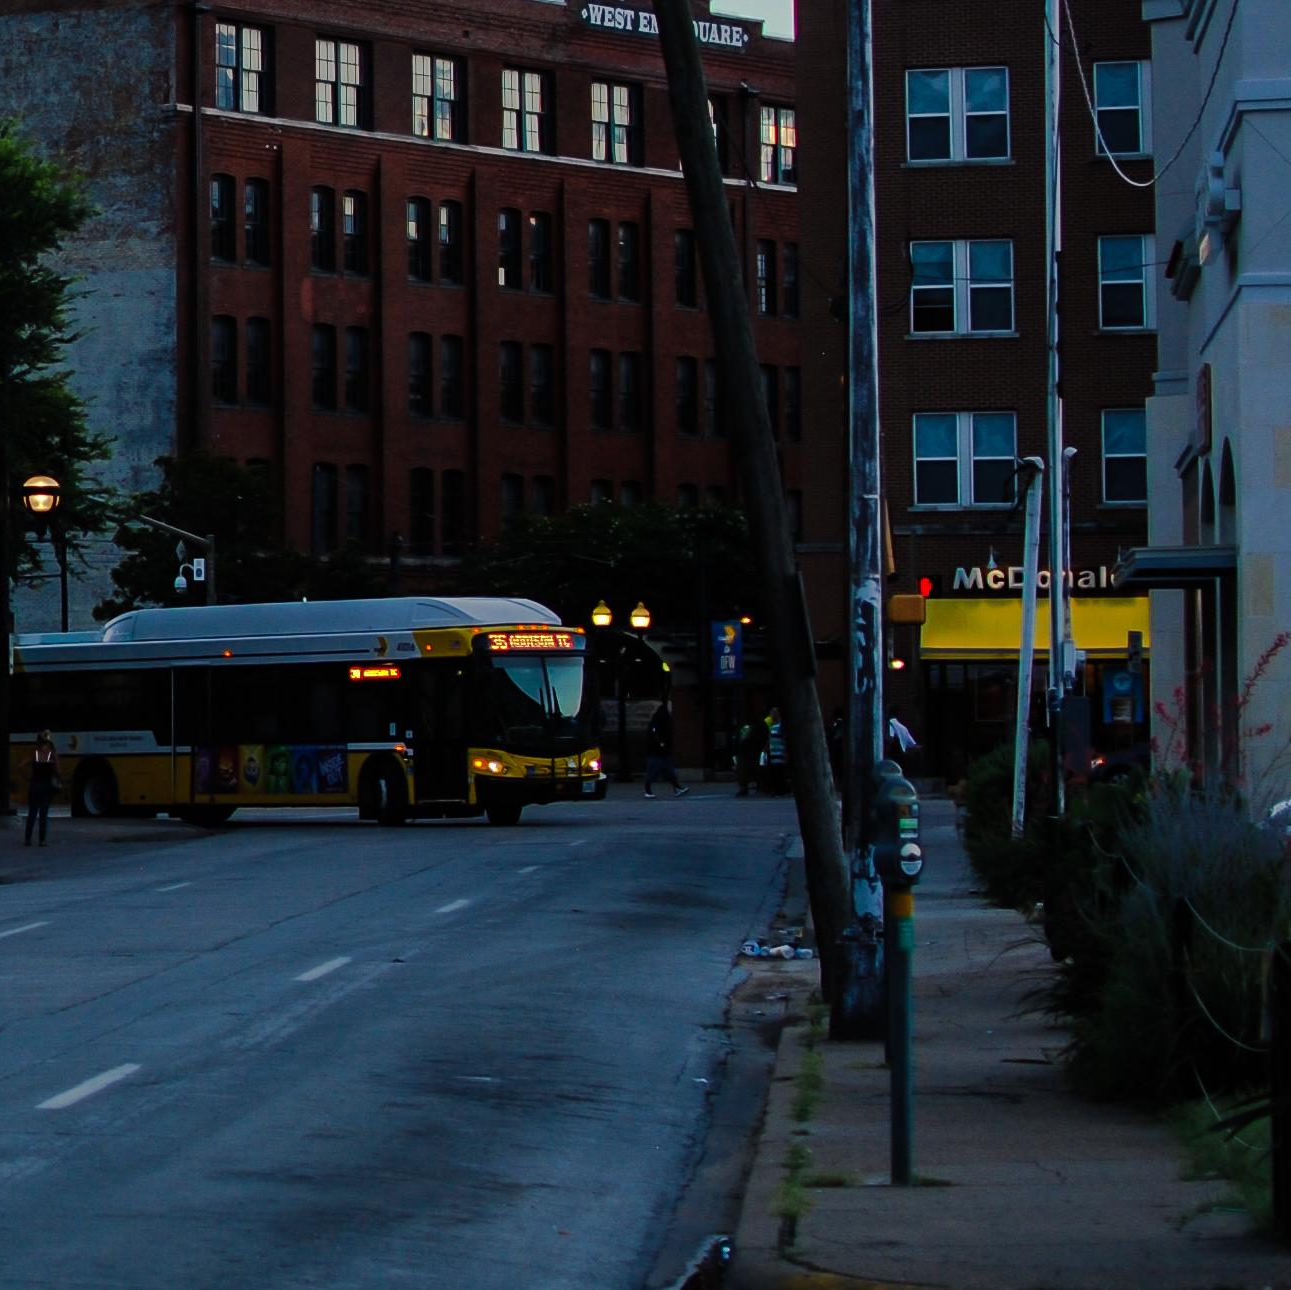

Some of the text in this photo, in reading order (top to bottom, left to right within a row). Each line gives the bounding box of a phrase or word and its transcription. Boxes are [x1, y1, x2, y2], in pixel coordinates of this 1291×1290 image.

[587, 3, 743, 47] WEST EN UARE
[952, 565, 1116, 590] McDonal
